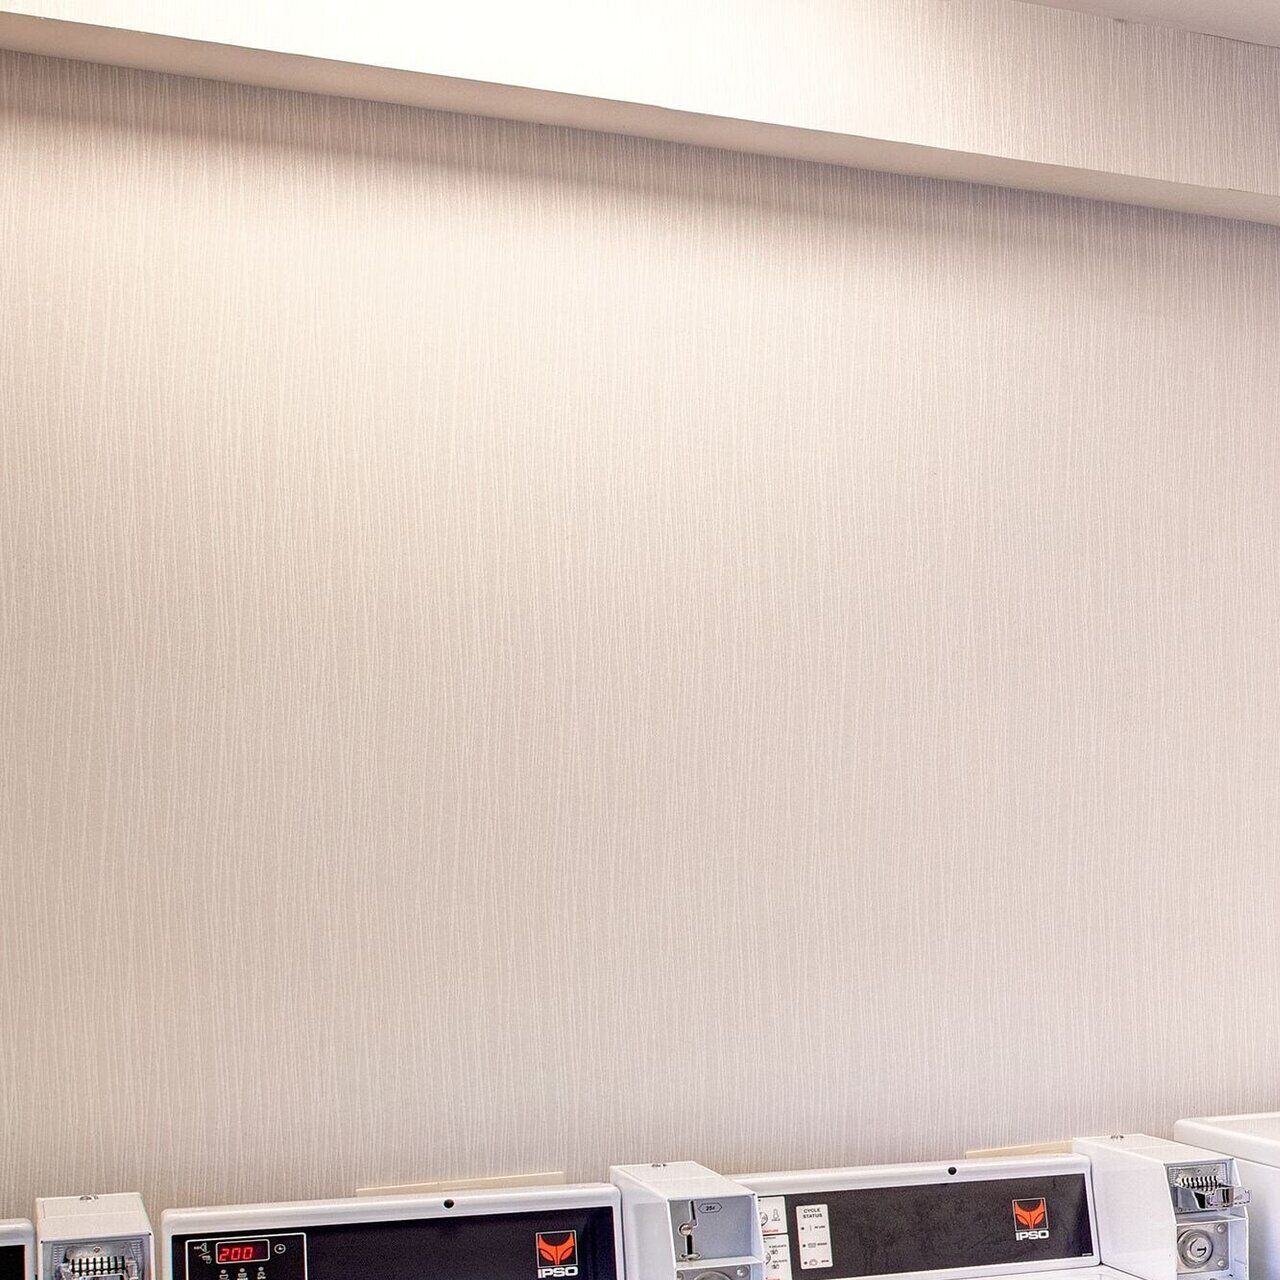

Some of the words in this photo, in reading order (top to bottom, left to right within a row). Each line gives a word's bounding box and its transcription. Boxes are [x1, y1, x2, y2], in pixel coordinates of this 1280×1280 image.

[1015, 1230, 1050, 1241] IPSO
[219, 1246, 254, 1262] 200
[537, 1266, 579, 1279] IPSO
